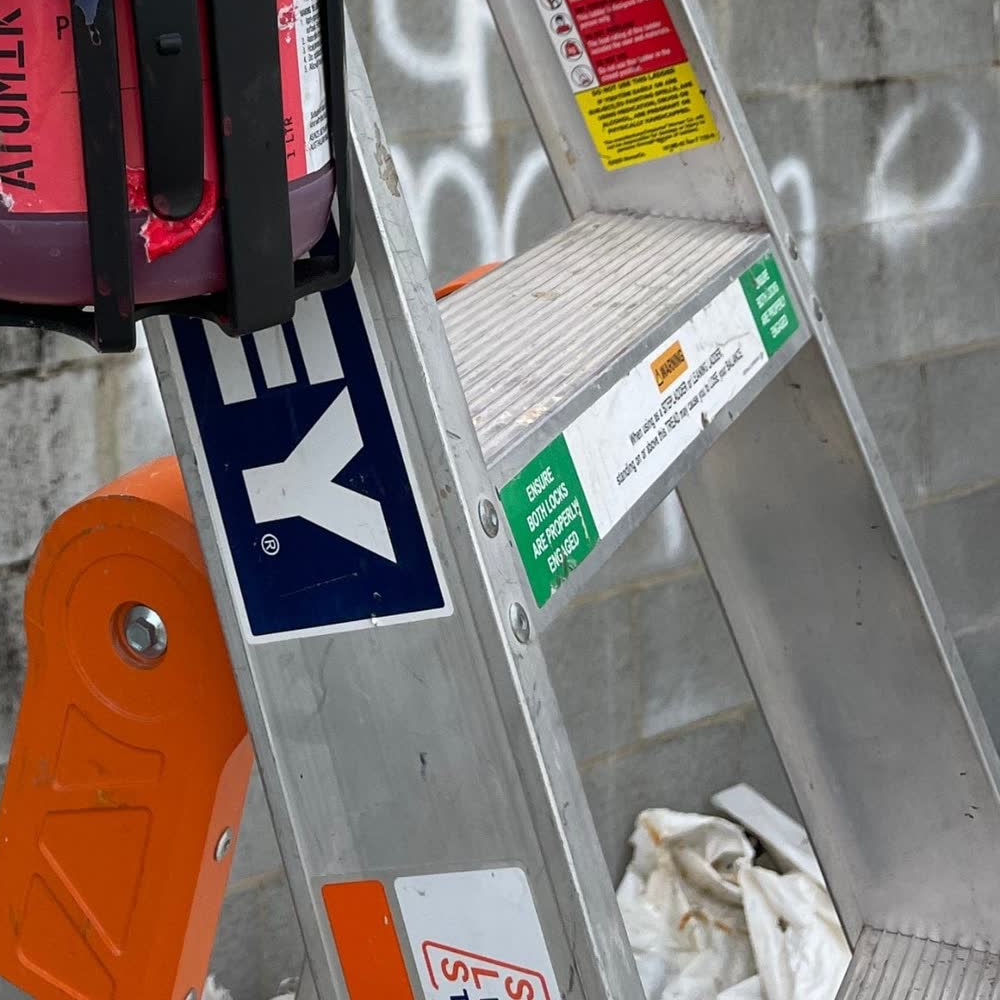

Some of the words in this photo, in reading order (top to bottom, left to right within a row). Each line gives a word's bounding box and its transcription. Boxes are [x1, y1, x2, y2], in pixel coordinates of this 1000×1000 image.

[56, 16, 69, 40] P
[662, 349, 685, 379] WARNING
[202, 291, 397, 564] EY
[616, 459, 637, 485] standing
[635, 454, 642, 465] on
[641, 448, 647, 459] or
[646, 436, 659, 454] above
[658, 427, 667, 441] this
[664, 412, 681, 432] TREAD
[629, 429, 643, 446] When
[642, 417, 656, 434] using
[525, 466, 554, 502] ENSURE
[526, 502, 548, 532] BOTH
[544, 482, 569, 514] LOCKS
[533, 533, 548, 560] ARE
[545, 498, 580, 541] PROPERLY
